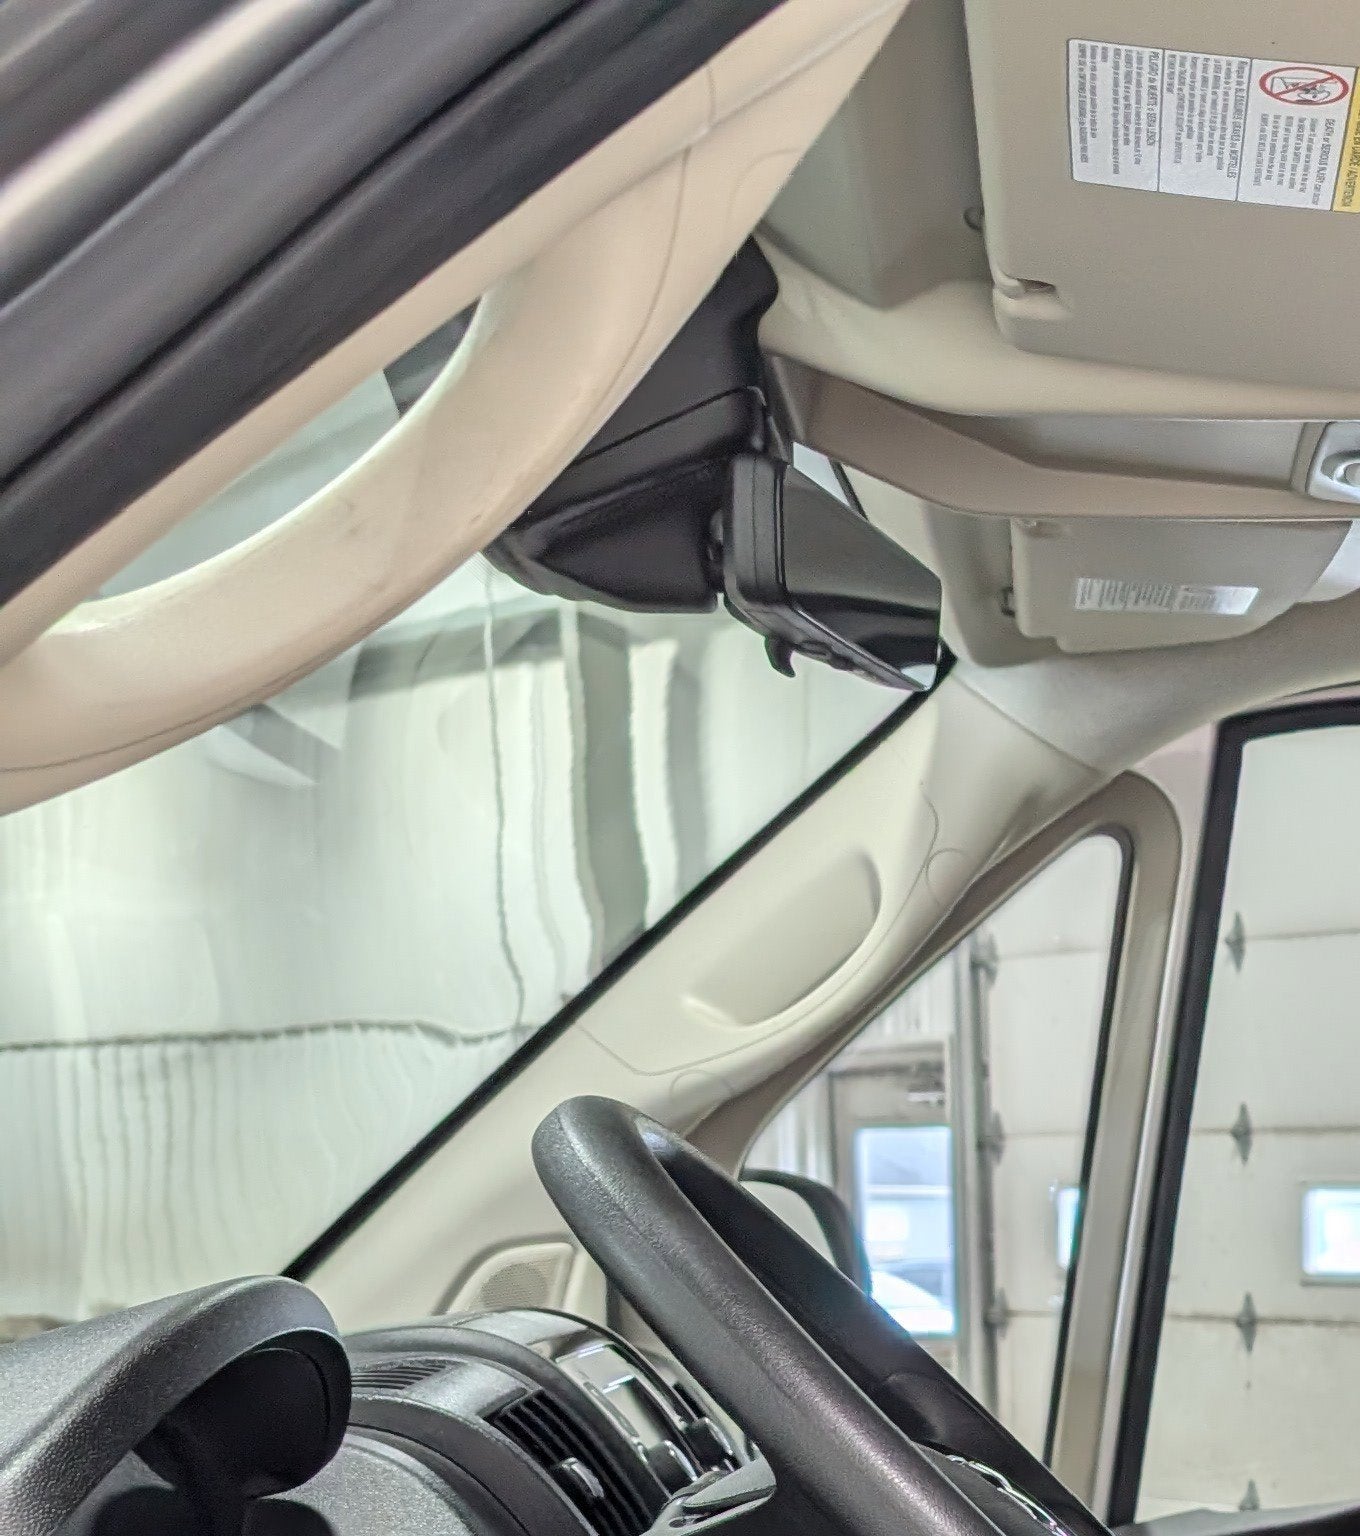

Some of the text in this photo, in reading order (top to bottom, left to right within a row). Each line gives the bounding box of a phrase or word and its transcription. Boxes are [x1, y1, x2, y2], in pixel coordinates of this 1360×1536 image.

[1322, 118, 1335, 136] DEATH
[1317, 143, 1331, 165] SERIOUS
[1340, 169, 1358, 207] ADVERTENCIA
